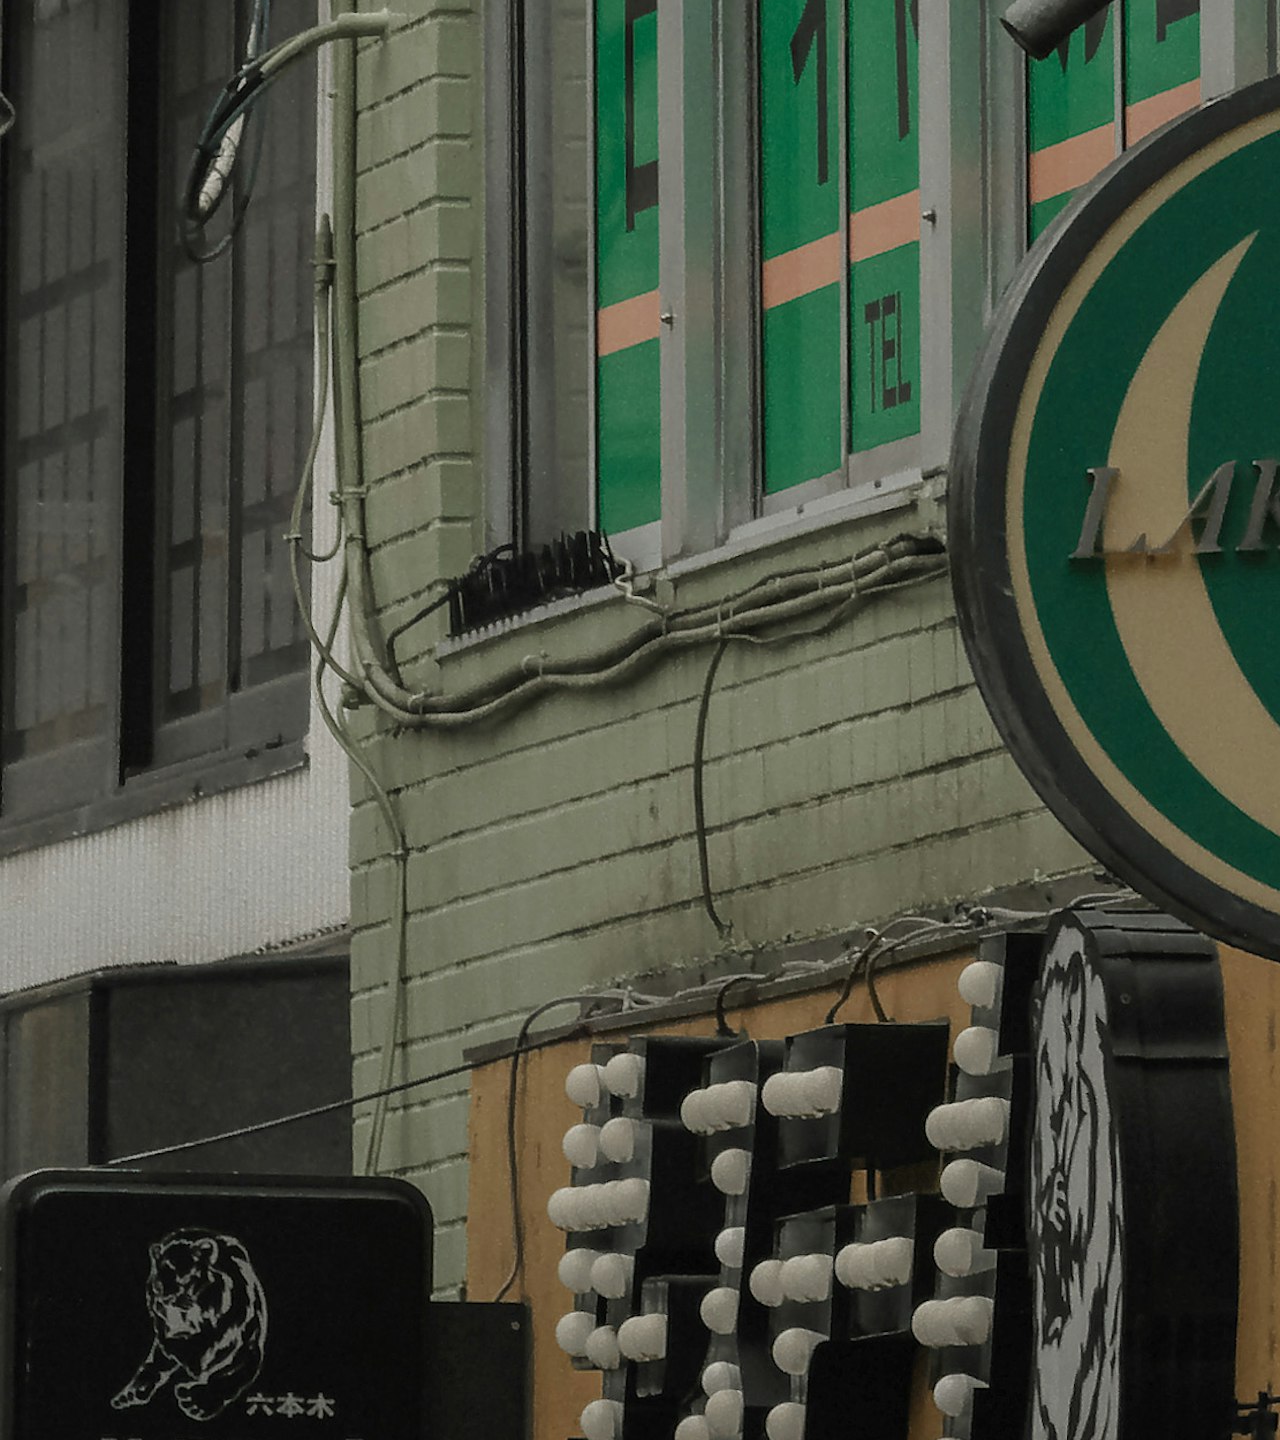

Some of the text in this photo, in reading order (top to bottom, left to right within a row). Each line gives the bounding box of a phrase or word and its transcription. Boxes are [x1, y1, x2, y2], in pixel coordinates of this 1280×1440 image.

[864, 291, 911, 414] TEL
[245, 1392, 336, 1419] 六本木
